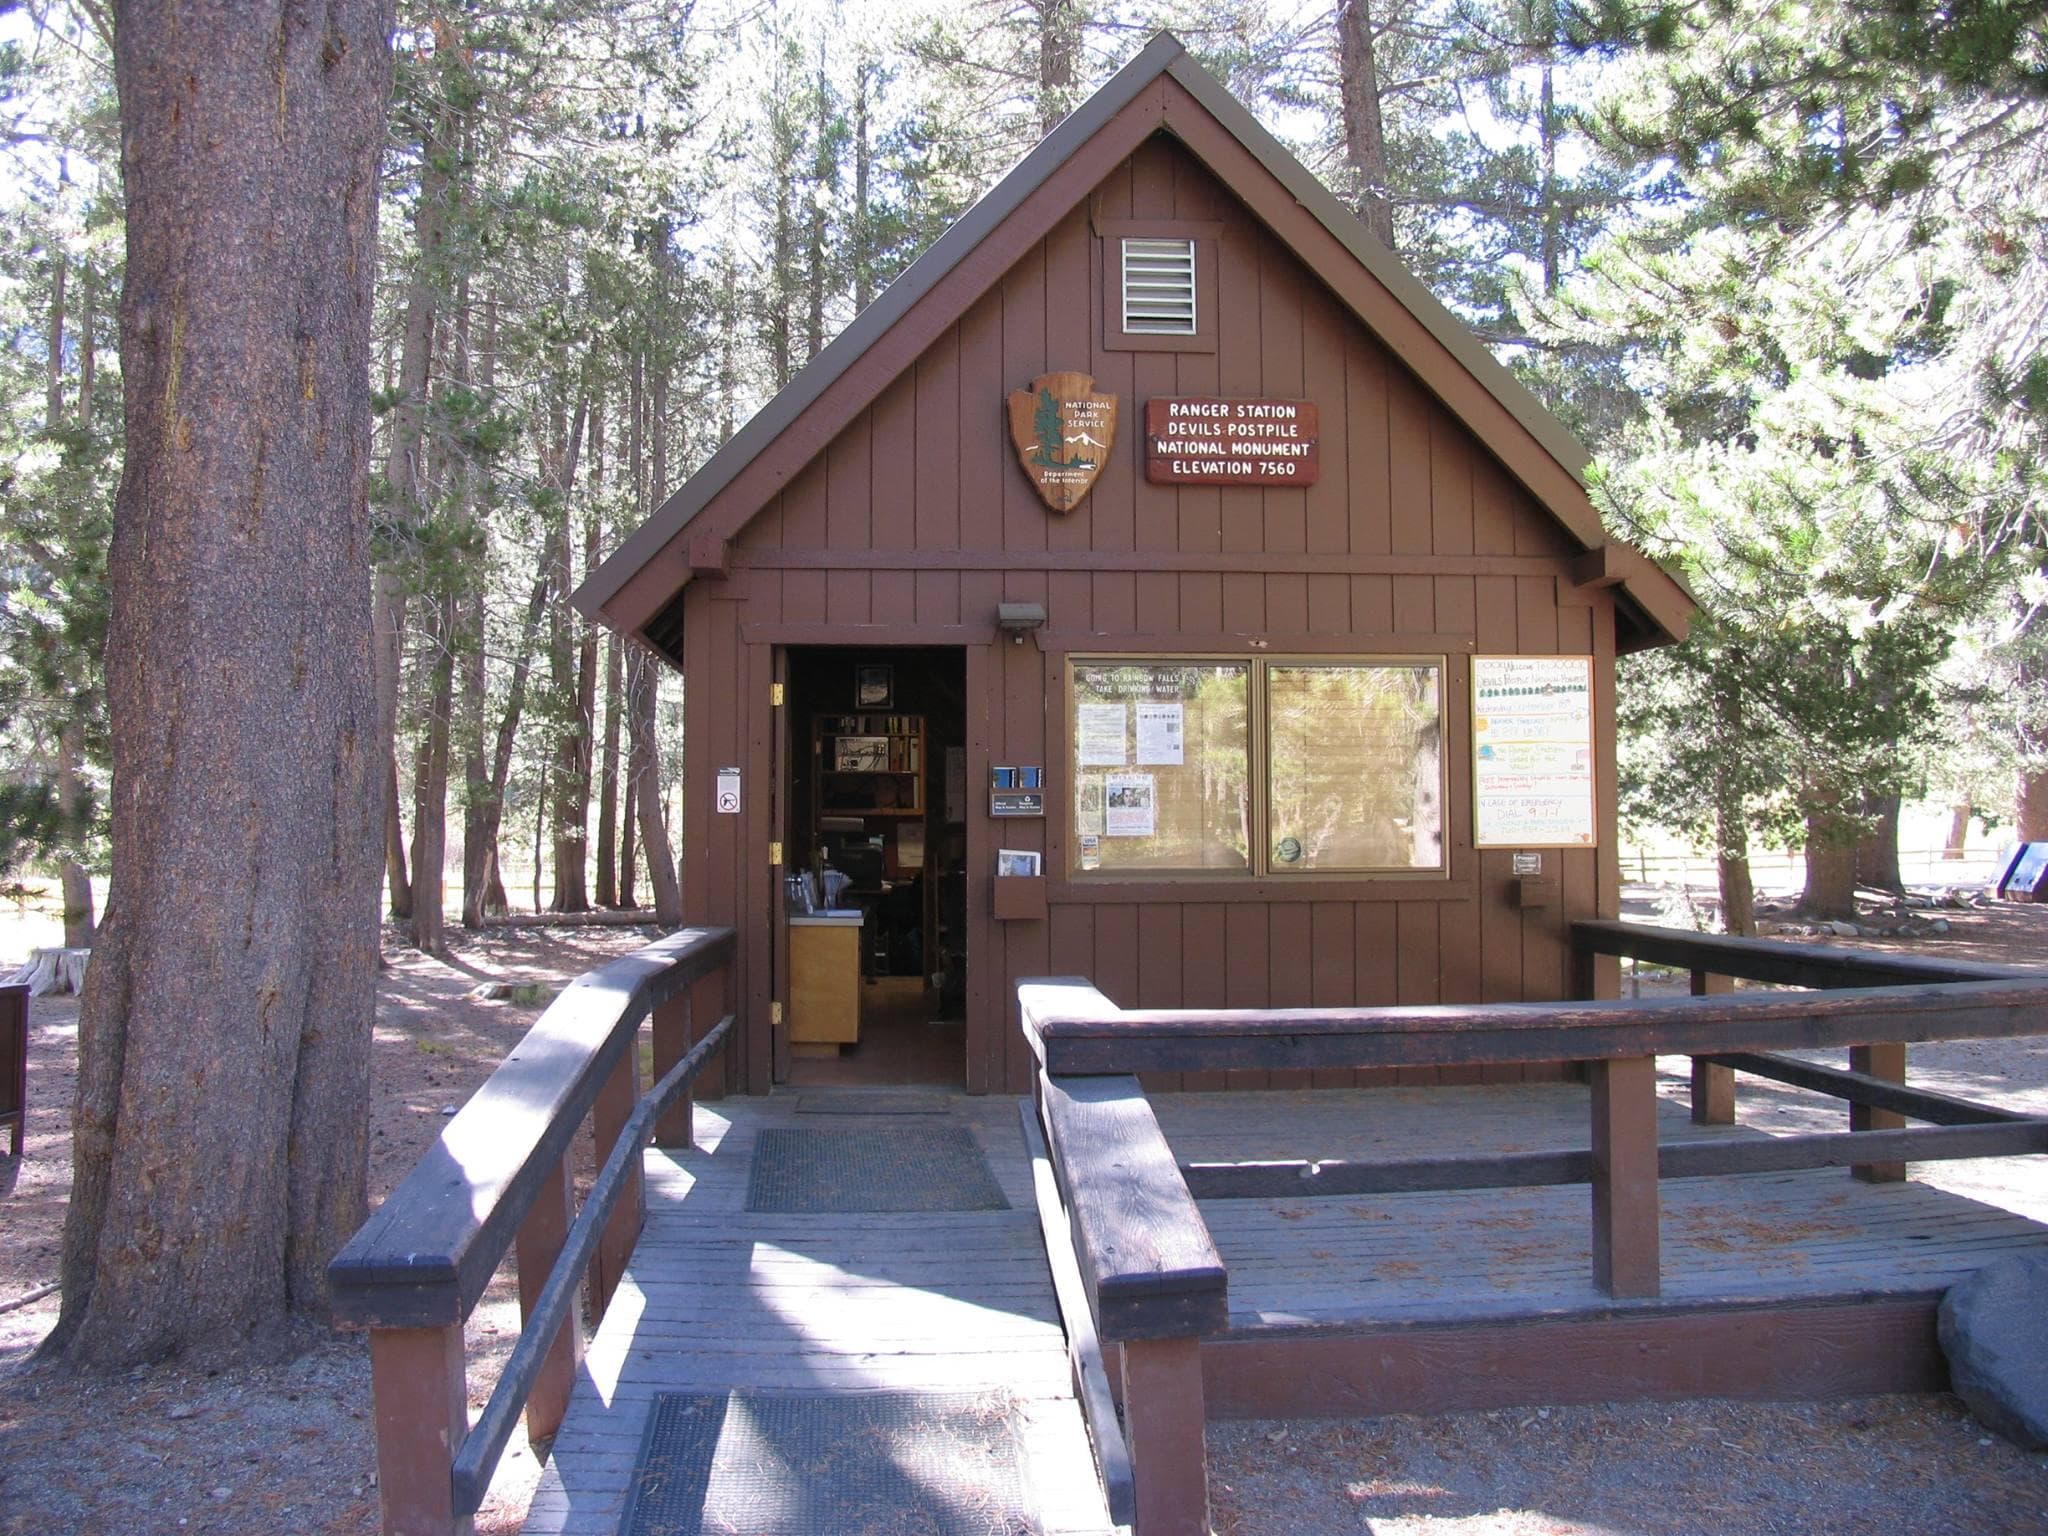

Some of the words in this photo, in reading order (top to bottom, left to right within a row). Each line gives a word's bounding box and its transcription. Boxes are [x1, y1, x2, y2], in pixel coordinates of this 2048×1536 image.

[1065, 401, 1111, 410] NATIONAL
[1074, 410, 1098, 419] PARK
[1169, 403, 1229, 417] RANGER
[1237, 405, 1296, 418] STATION
[1067, 419, 1105, 428] SERVICE
[1168, 422, 1221, 436] DEVILS
[1227, 423, 1298, 437] POSTPILE
[1157, 441, 1226, 455] NATIONAL
[1231, 443, 1310, 456] MONUMENT
[1172, 460, 1252, 475] ELEVATION
[1259, 462, 1296, 475] 7560
[1044, 471, 1085, 479] Department
[1111, 674, 1120, 682] TO
[1158, 674, 1179, 682] FALLS
[1096, 685, 1113, 693] TAKE
[1156, 685, 1179, 694] WATER
